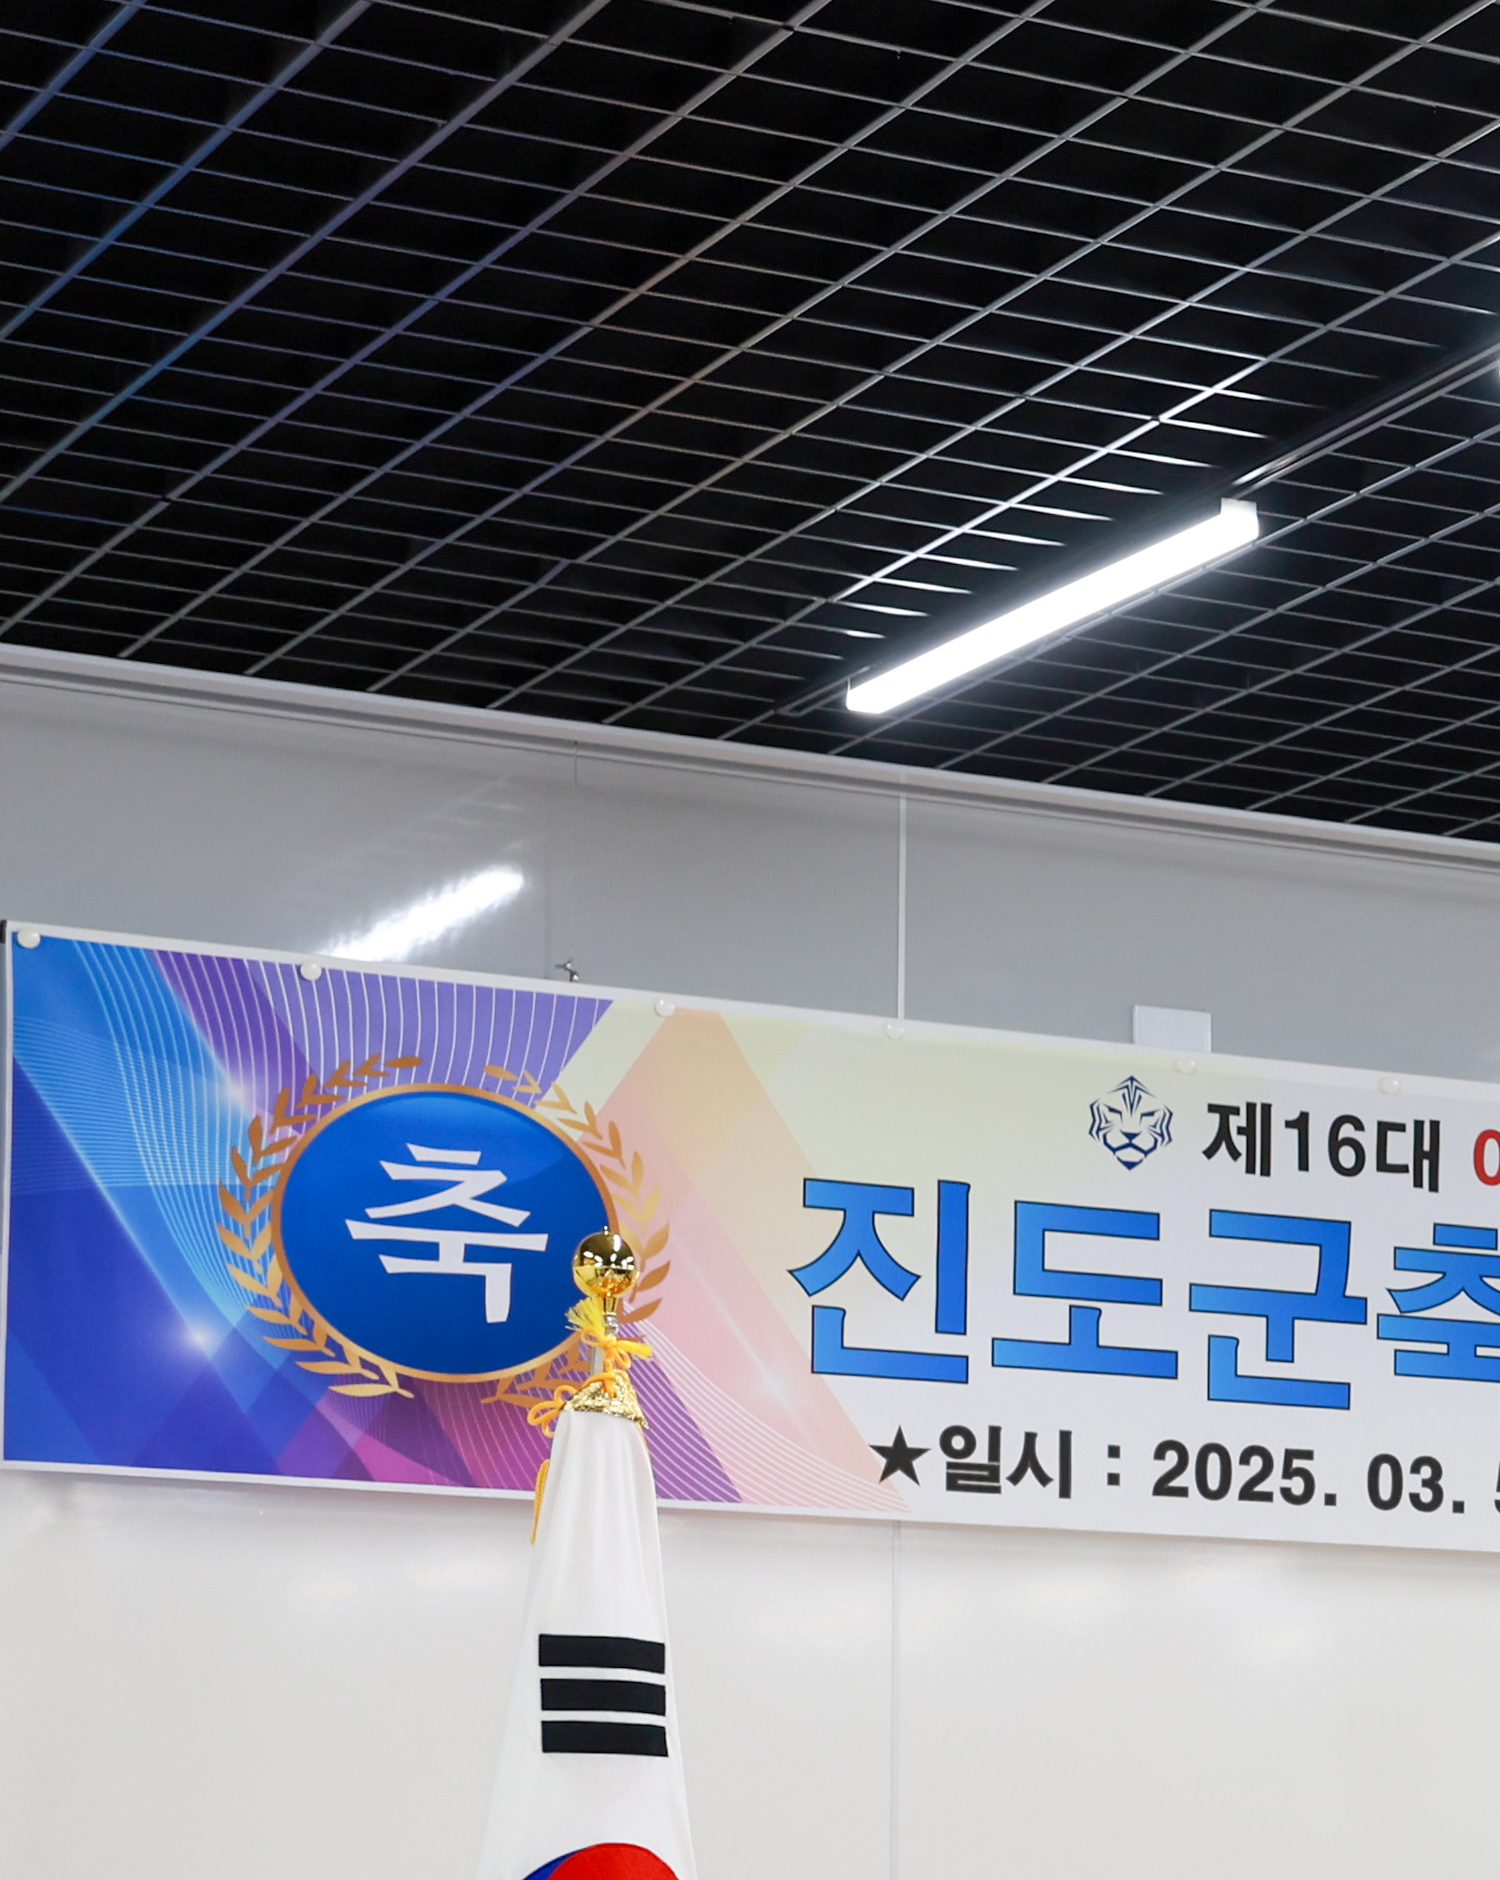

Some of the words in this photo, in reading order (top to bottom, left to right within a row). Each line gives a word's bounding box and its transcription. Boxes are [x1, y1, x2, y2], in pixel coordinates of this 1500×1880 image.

[1202, 1101, 1441, 1193] 제16대
[345, 1142, 548, 1324] 축
[1151, 1438, 1338, 1508] 2025.
[1366, 1453, 1466, 1514] 03.
